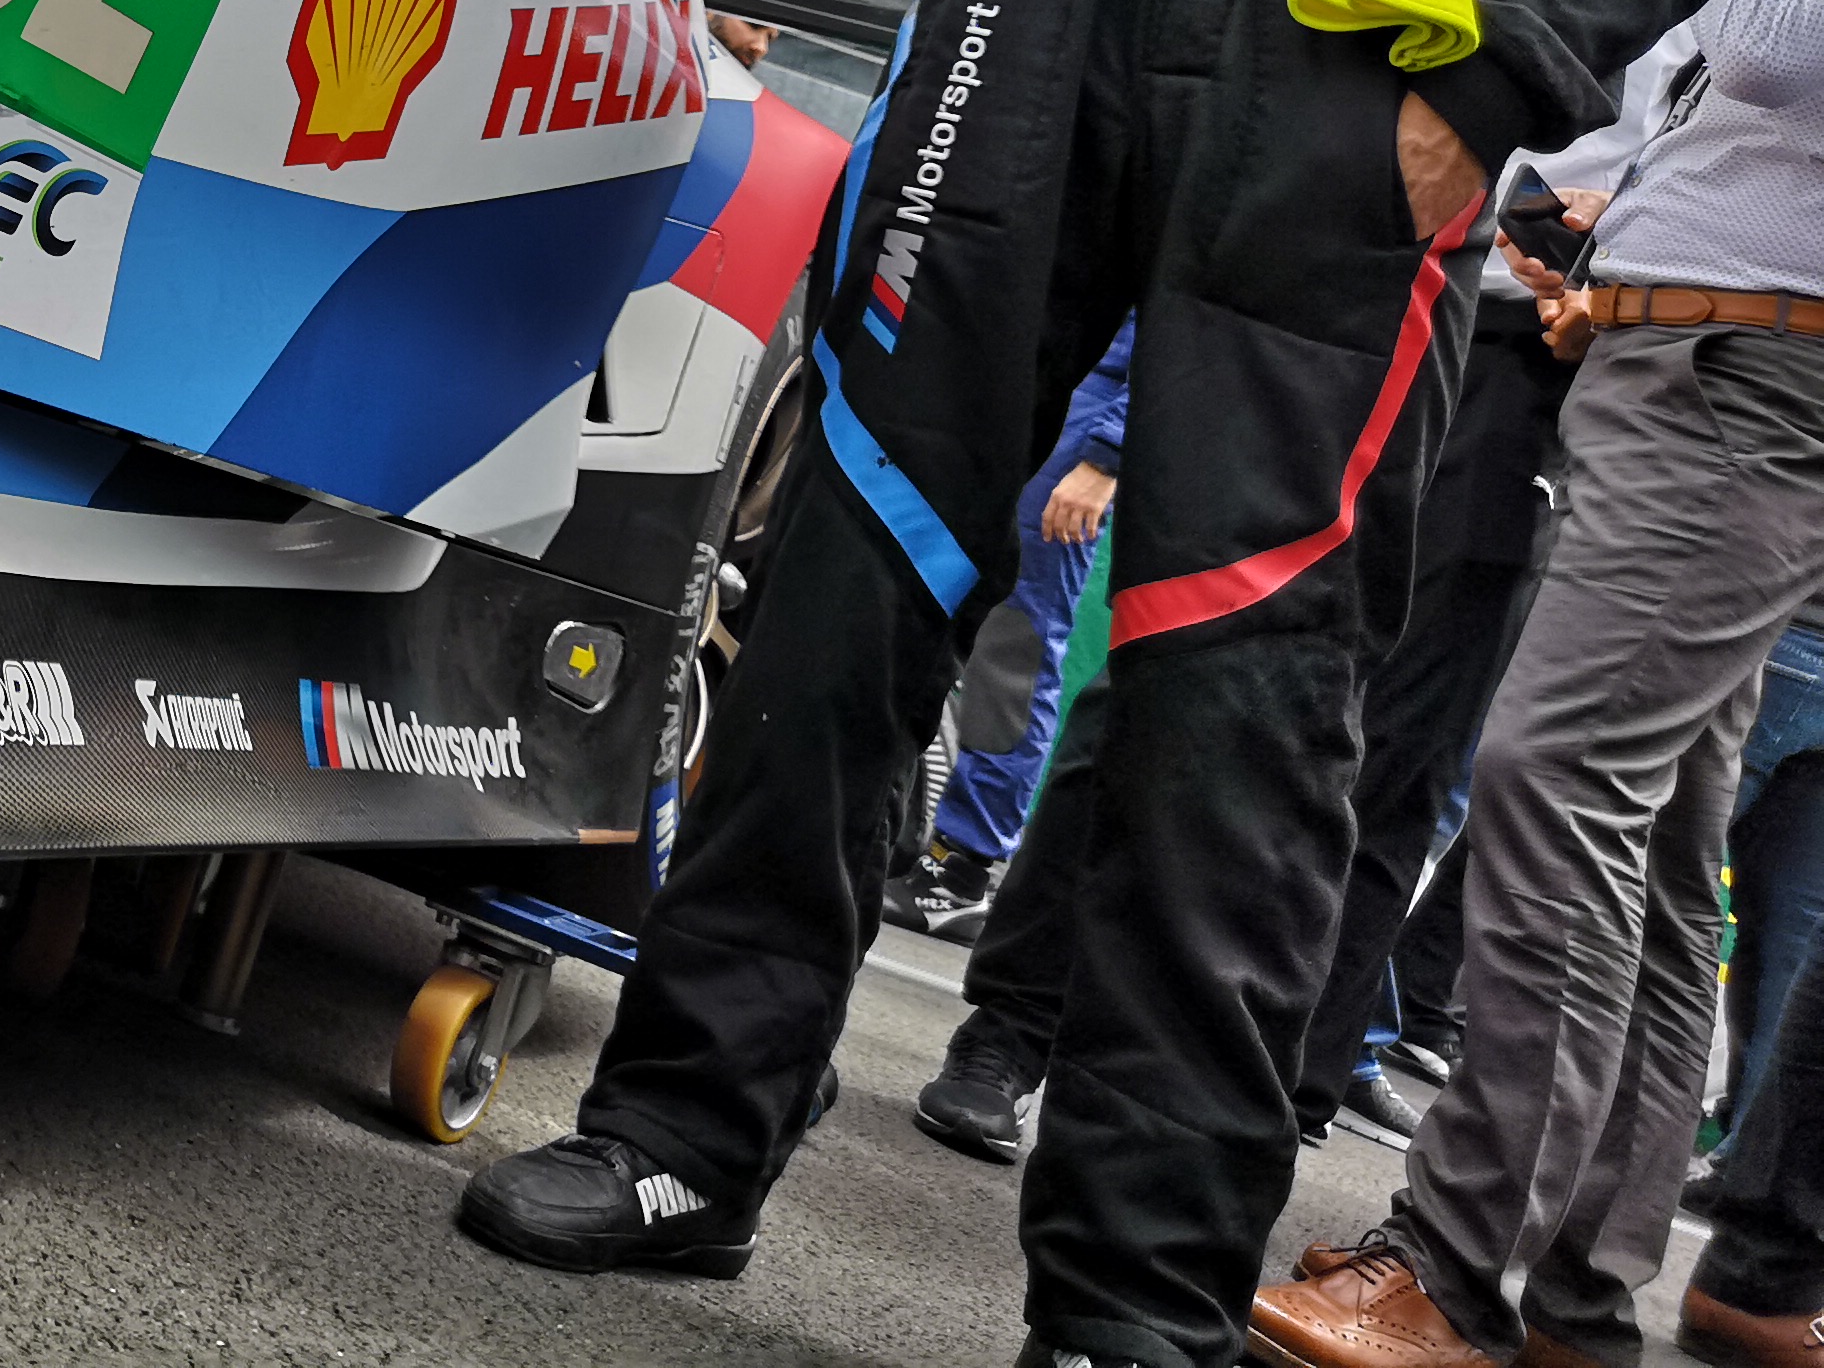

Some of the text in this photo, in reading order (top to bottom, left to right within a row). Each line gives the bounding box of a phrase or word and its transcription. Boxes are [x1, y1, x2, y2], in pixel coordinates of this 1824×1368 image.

[481, 0, 706, 141] HELIX
[896, 2, 1002, 225] Motorsport
[368, 700, 526, 791] Motorsport
